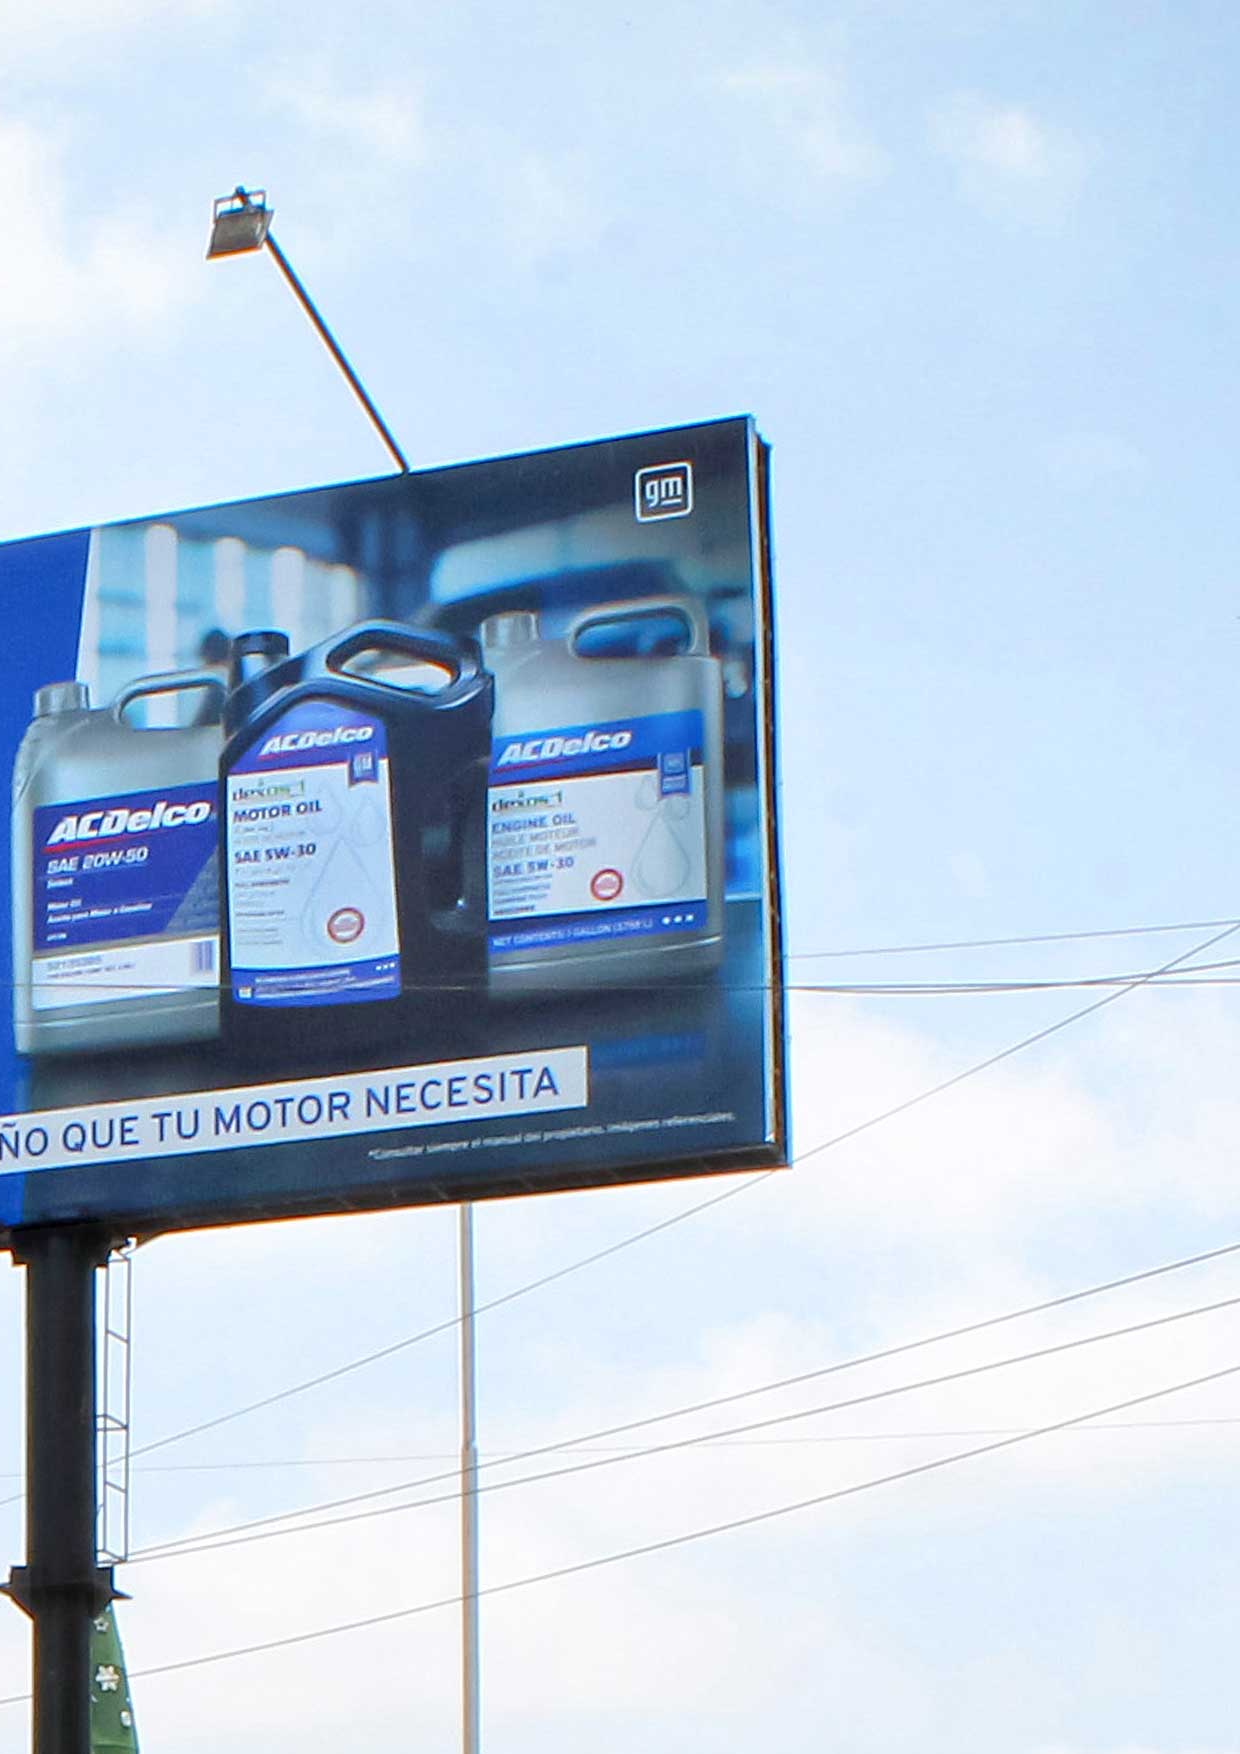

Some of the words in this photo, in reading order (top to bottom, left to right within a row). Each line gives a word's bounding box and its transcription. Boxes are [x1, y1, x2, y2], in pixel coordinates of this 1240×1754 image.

[645, 477, 683, 508] gm
[260, 726, 374, 756] ACDelco
[497, 731, 633, 766] ACDelco
[47, 801, 211, 846] ACDelco
[233, 804, 292, 824] MOTOR
[296, 800, 323, 816] OIL
[552, 811, 577, 827] OIL
[47, 856, 80, 874] SAE
[83, 846, 149, 870] 20W-50
[234, 849, 262, 865] SAE
[265, 843, 317, 861] 5W-30
[493, 861, 524, 877] SAE
[527, 856, 575, 874] 5W-30
[62, 1116, 139, 1154] QUE
[152, 1108, 200, 1141] TU
[214, 1091, 352, 1137] MOTOR
[365, 1066, 560, 1117] NECESITA
